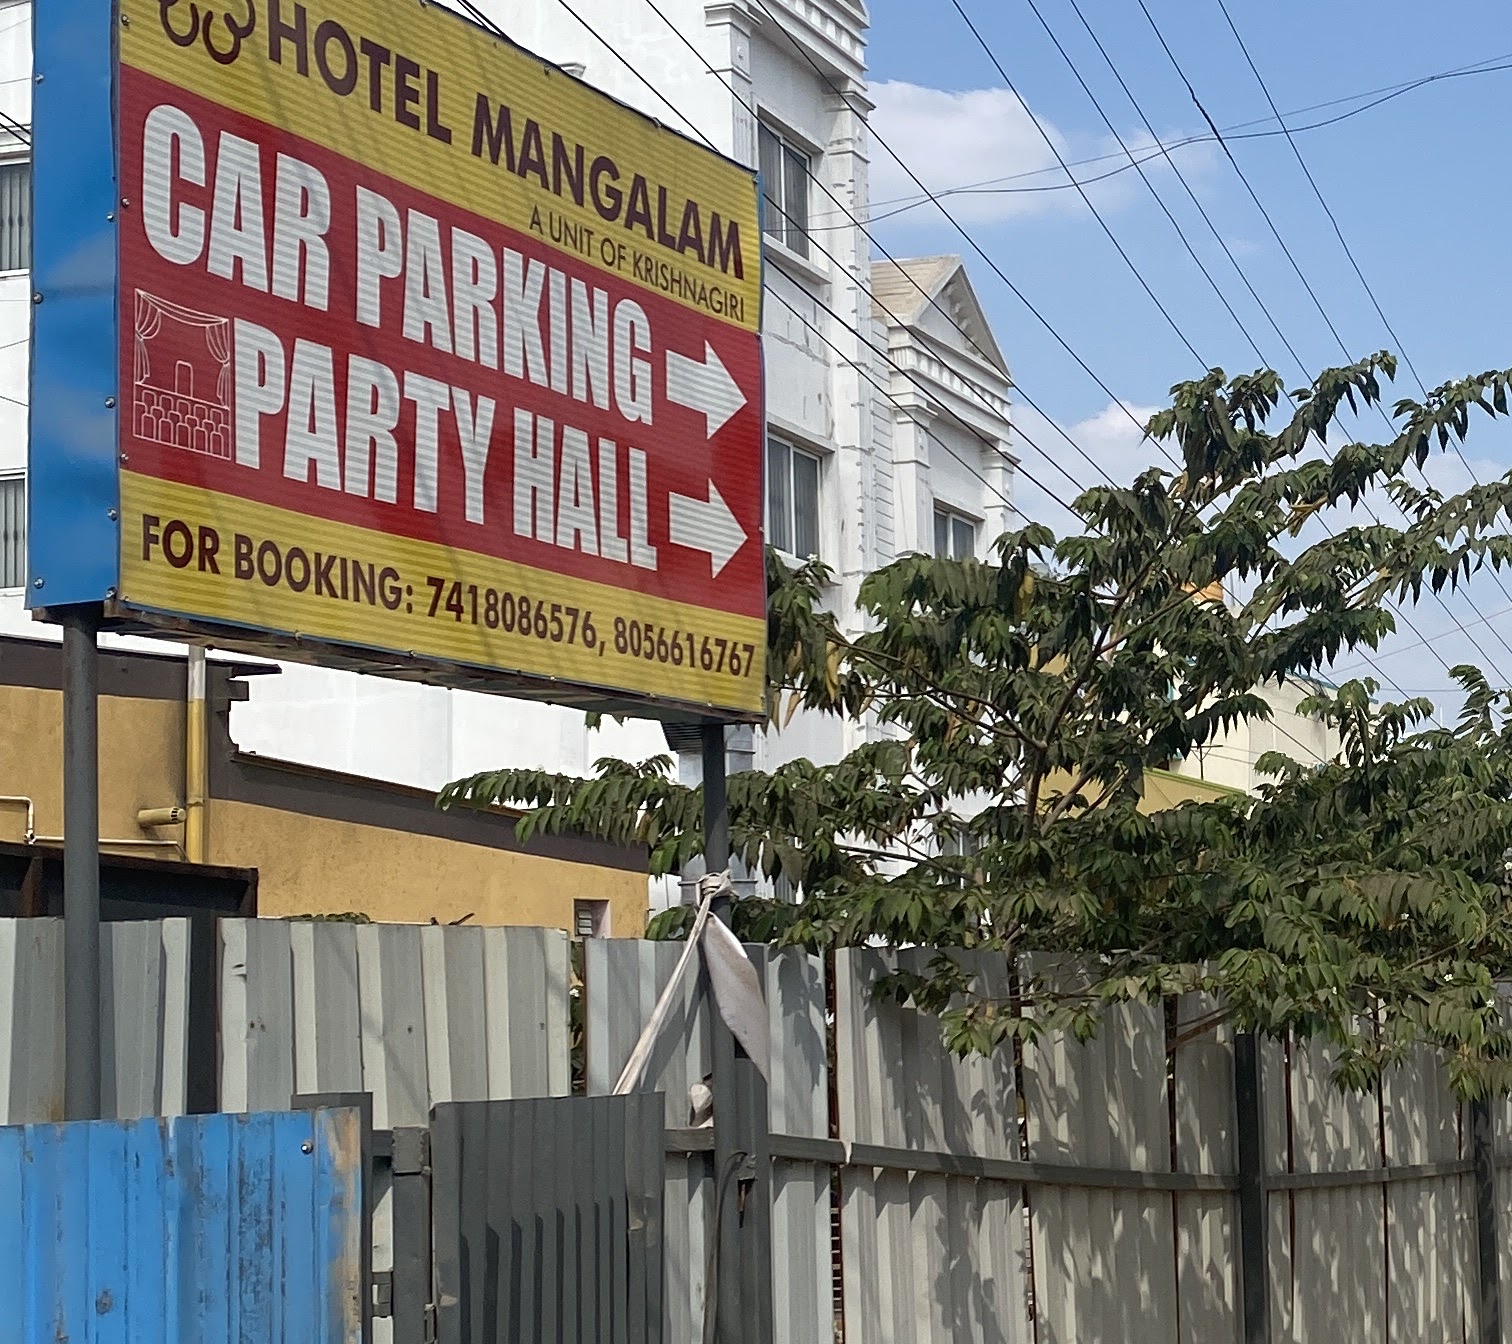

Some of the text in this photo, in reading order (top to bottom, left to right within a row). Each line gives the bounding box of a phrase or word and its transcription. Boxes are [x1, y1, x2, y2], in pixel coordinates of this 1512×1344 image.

[141, 104, 654, 426] CAR PARKING
[471, 93, 745, 281] MANGALAM
[529, 204, 746, 324] A UNIT OF KRISHNAGIRI
[233, 316, 658, 572] PARTY HALL
[142, 513, 756, 678] FOR BOOKING: 7418086576, 8056616767
